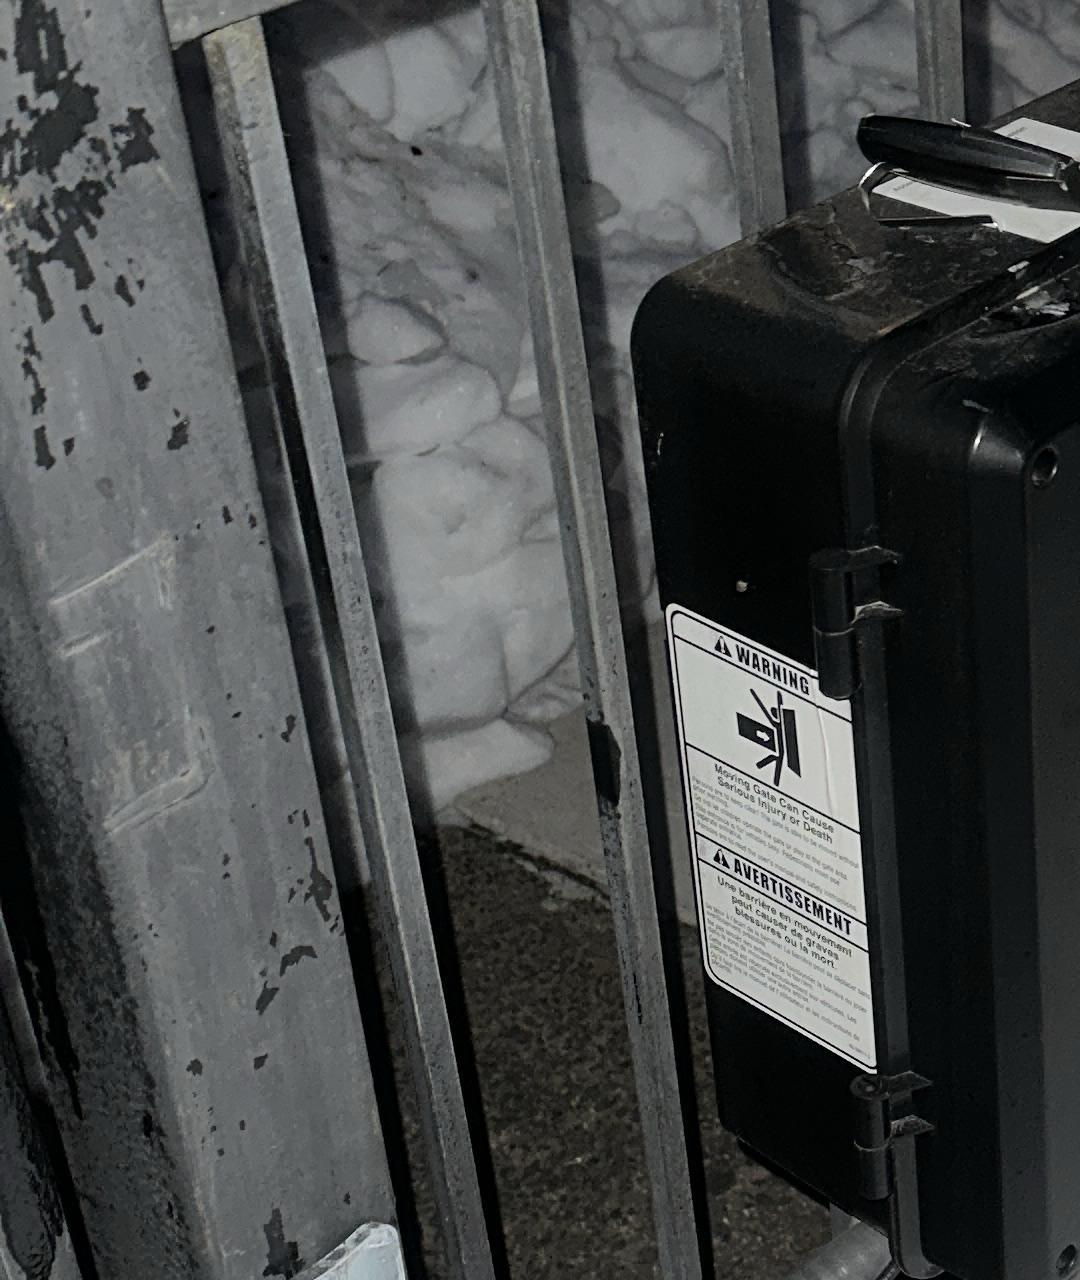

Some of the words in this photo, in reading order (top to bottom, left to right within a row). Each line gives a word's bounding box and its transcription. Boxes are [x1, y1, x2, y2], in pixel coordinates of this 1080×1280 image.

[735, 643, 810, 696] WARNING
[714, 763, 751, 791] Moving
[753, 784, 777, 803] Gate
[779, 797, 800, 815] Can
[802, 807, 835, 834] Cause
[717, 776, 755, 803] Serious
[758, 798, 787, 822] Injury
[789, 816, 800, 827] or
[803, 821, 834, 844] Death
[717, 875, 737, 893] Une
[738, 889, 777, 915] barrière
[779, 911, 791, 922] en
[794, 920, 853, 958] mouvement
[731, 895, 753, 912] peut
[755, 909, 788, 931] causer
[791, 927, 803, 940] de
[806, 937, 840, 961] graves
[734, 857, 852, 936] AVERTISSEMENT
[735, 906, 782, 939] blessures
[784, 934, 798, 947] ou
[800, 942, 809, 955] la
